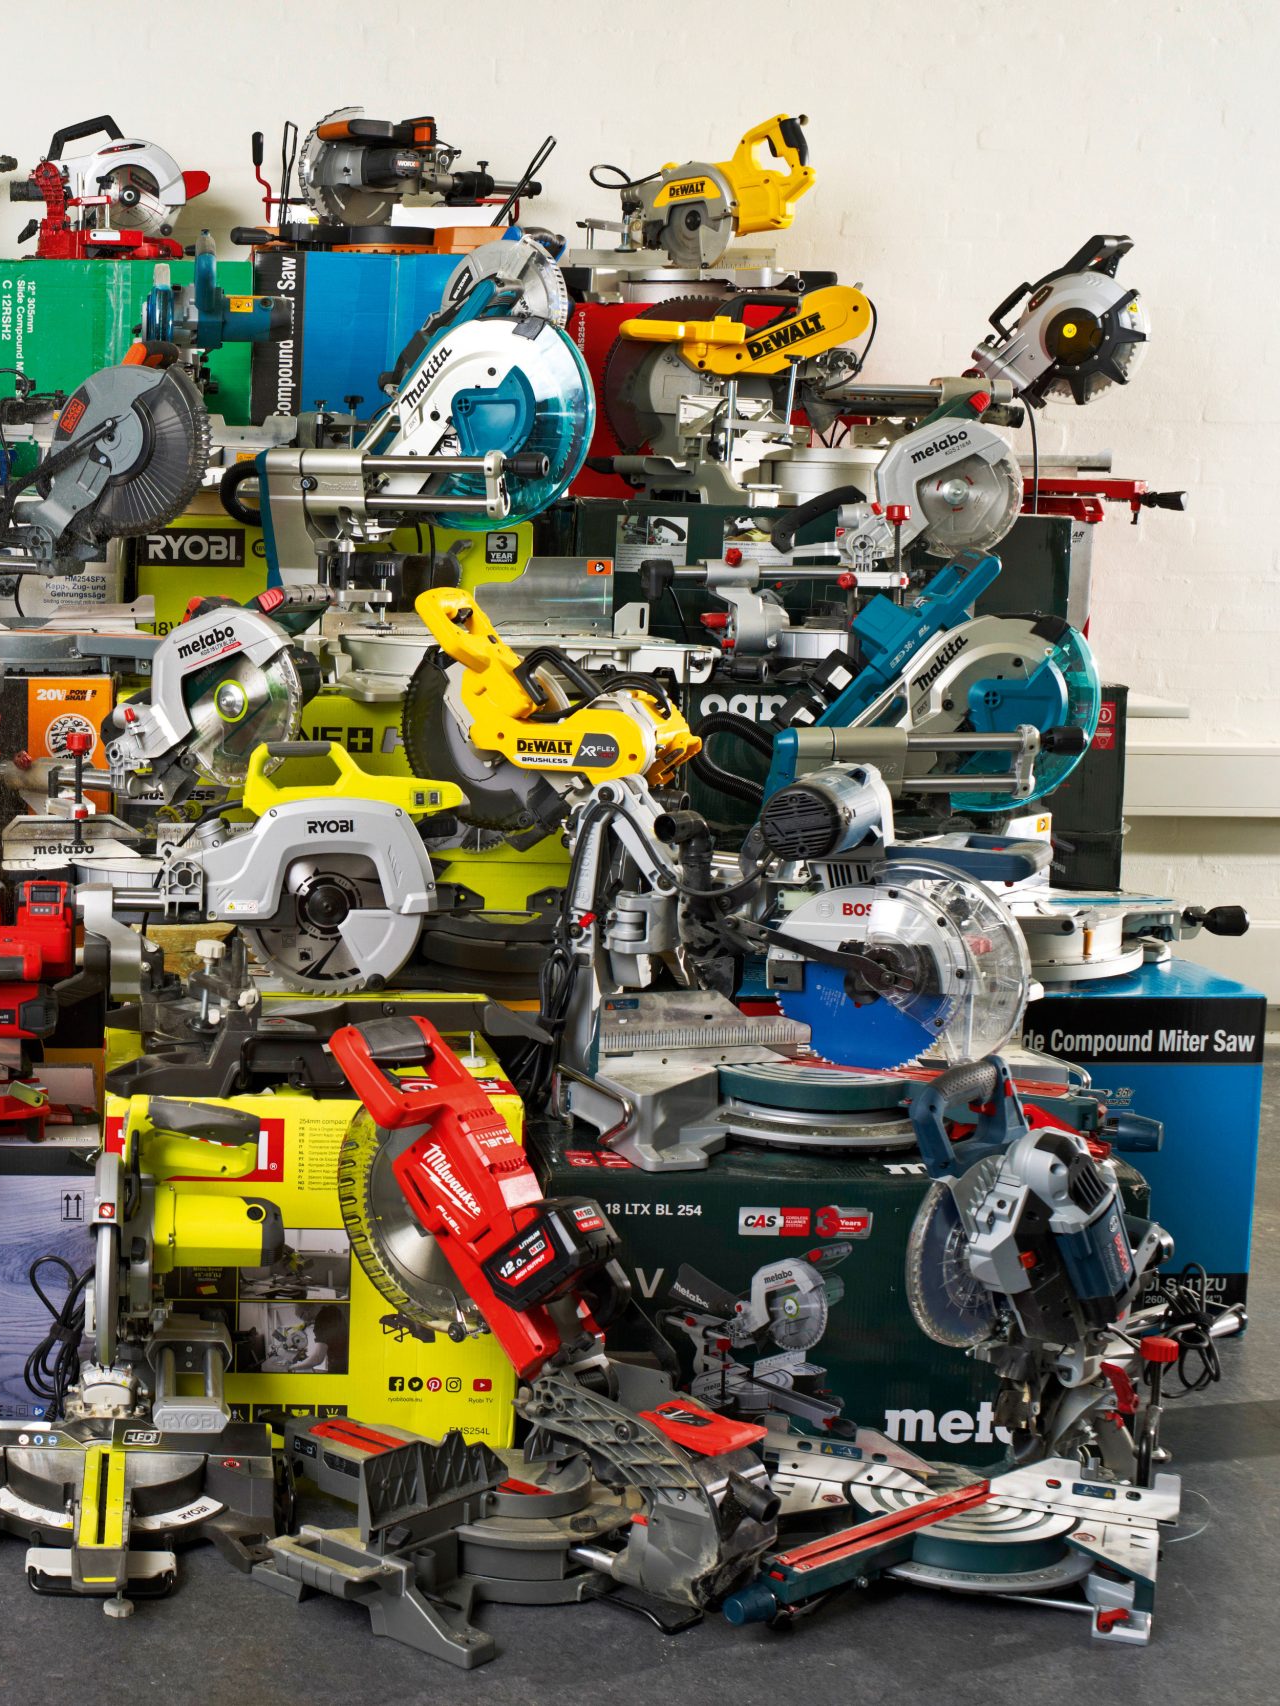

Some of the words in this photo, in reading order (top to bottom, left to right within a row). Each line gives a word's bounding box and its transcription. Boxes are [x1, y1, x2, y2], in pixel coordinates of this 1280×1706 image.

[2, 280, 12, 289] C
[277, 257, 296, 290] Saw
[17, 280, 26, 302] Slide
[2, 293, 12, 341] 12RSH2
[27, 298, 36, 333] 305mm
[16, 306, 26, 360] Compound
[910, 430, 968, 464] metabo
[146, 535, 238, 560] RYOBI
[496, 536, 508, 550] 3
[178, 626, 234, 660] metabo
[36, 689, 66, 701] 20V
[580, 745, 597, 758] XR
[307, 820, 354, 834] RYOBI
[842, 903, 873, 916] BOS
[1050, 1029, 1152, 1056] Compound
[1158, 1030, 1208, 1052] Miter
[1213, 1030, 1256, 1052] Saw
[480, 1134, 514, 1148] FUEL
[422, 1142, 480, 1216] Milwaukee
[436, 1204, 461, 1236] FUEL
[606, 1204, 620, 1214] 18
[625, 1204, 650, 1215] LTX
[655, 1204, 673, 1216] BL
[678, 1204, 702, 1216] 254
[744, 1214, 776, 1228] CAS
[764, 1270, 792, 1284] metabo
[673, 1281, 710, 1309] metabo
[885, 1402, 1013, 1444] met
[134, 1432, 153, 1442] LED
[177, 1505, 210, 1520] RYOBI
